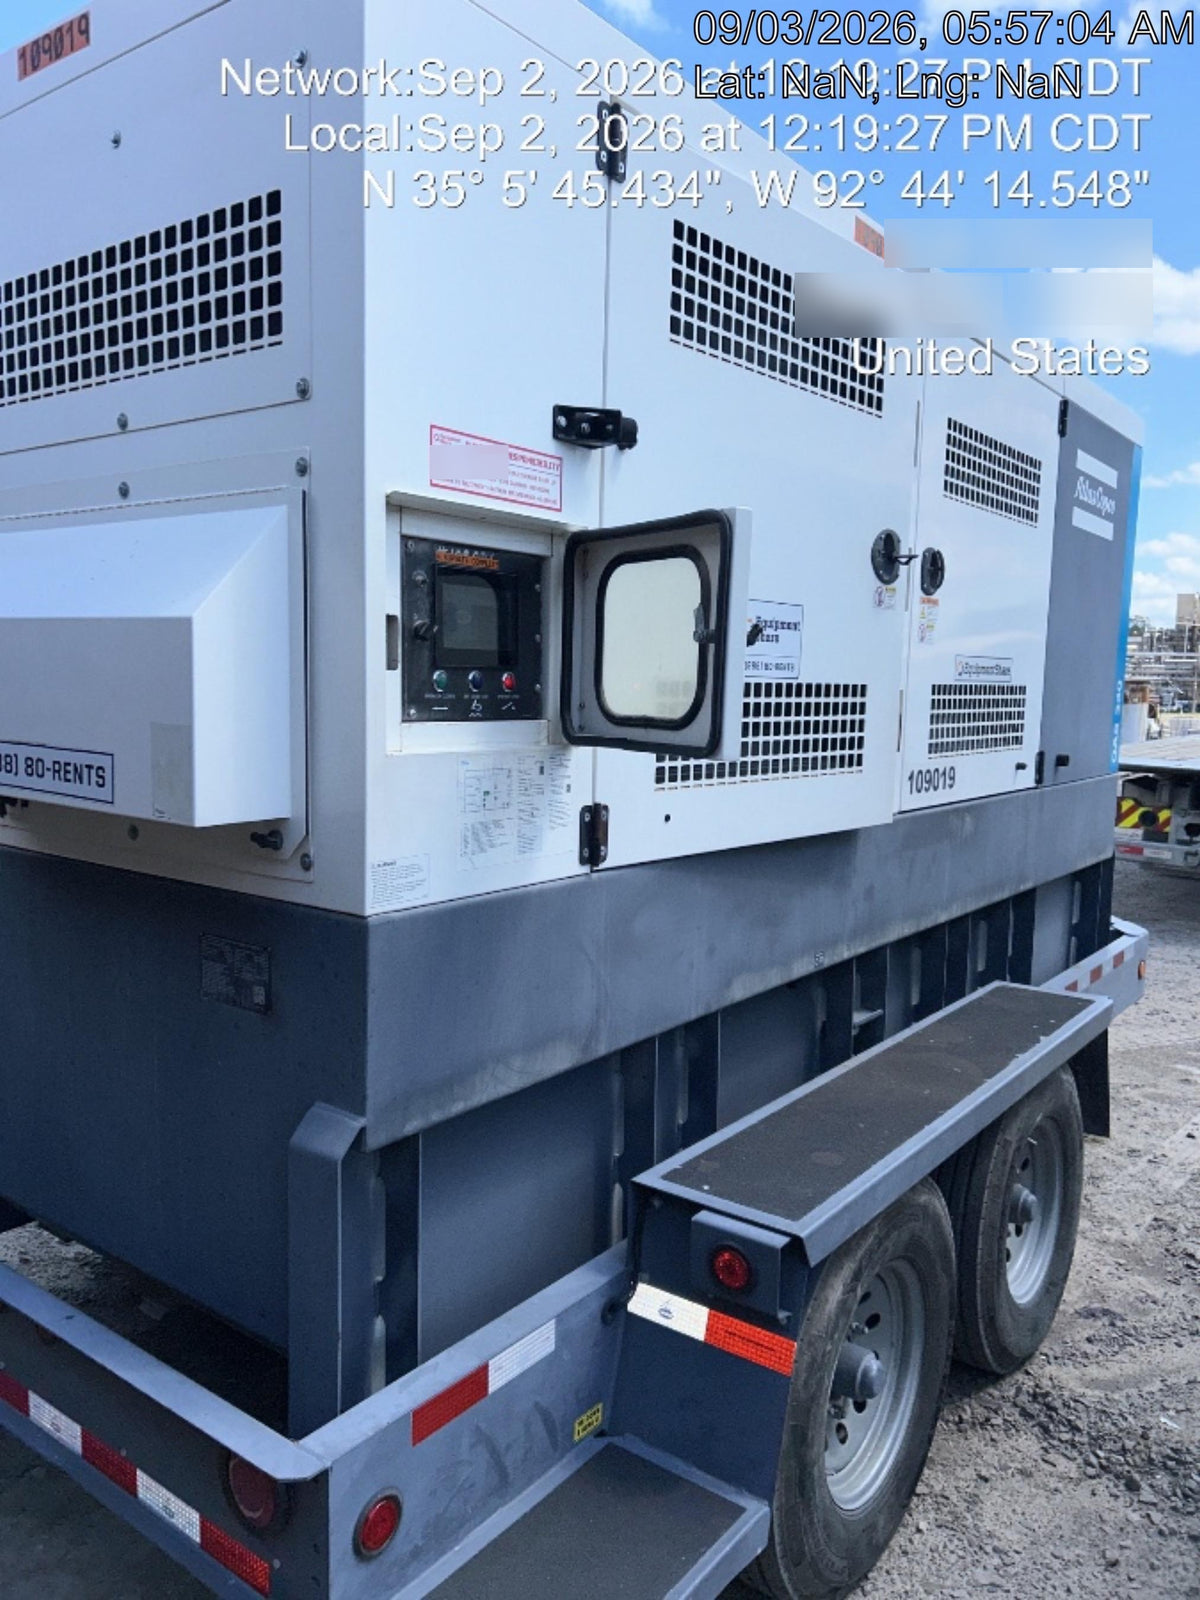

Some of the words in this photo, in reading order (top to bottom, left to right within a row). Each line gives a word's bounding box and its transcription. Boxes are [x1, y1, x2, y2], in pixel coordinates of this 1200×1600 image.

[18, 11, 90, 78] 109019
[24, 757, 106, 789] 80-RENTS
[908, 766, 956, 795] 109019
